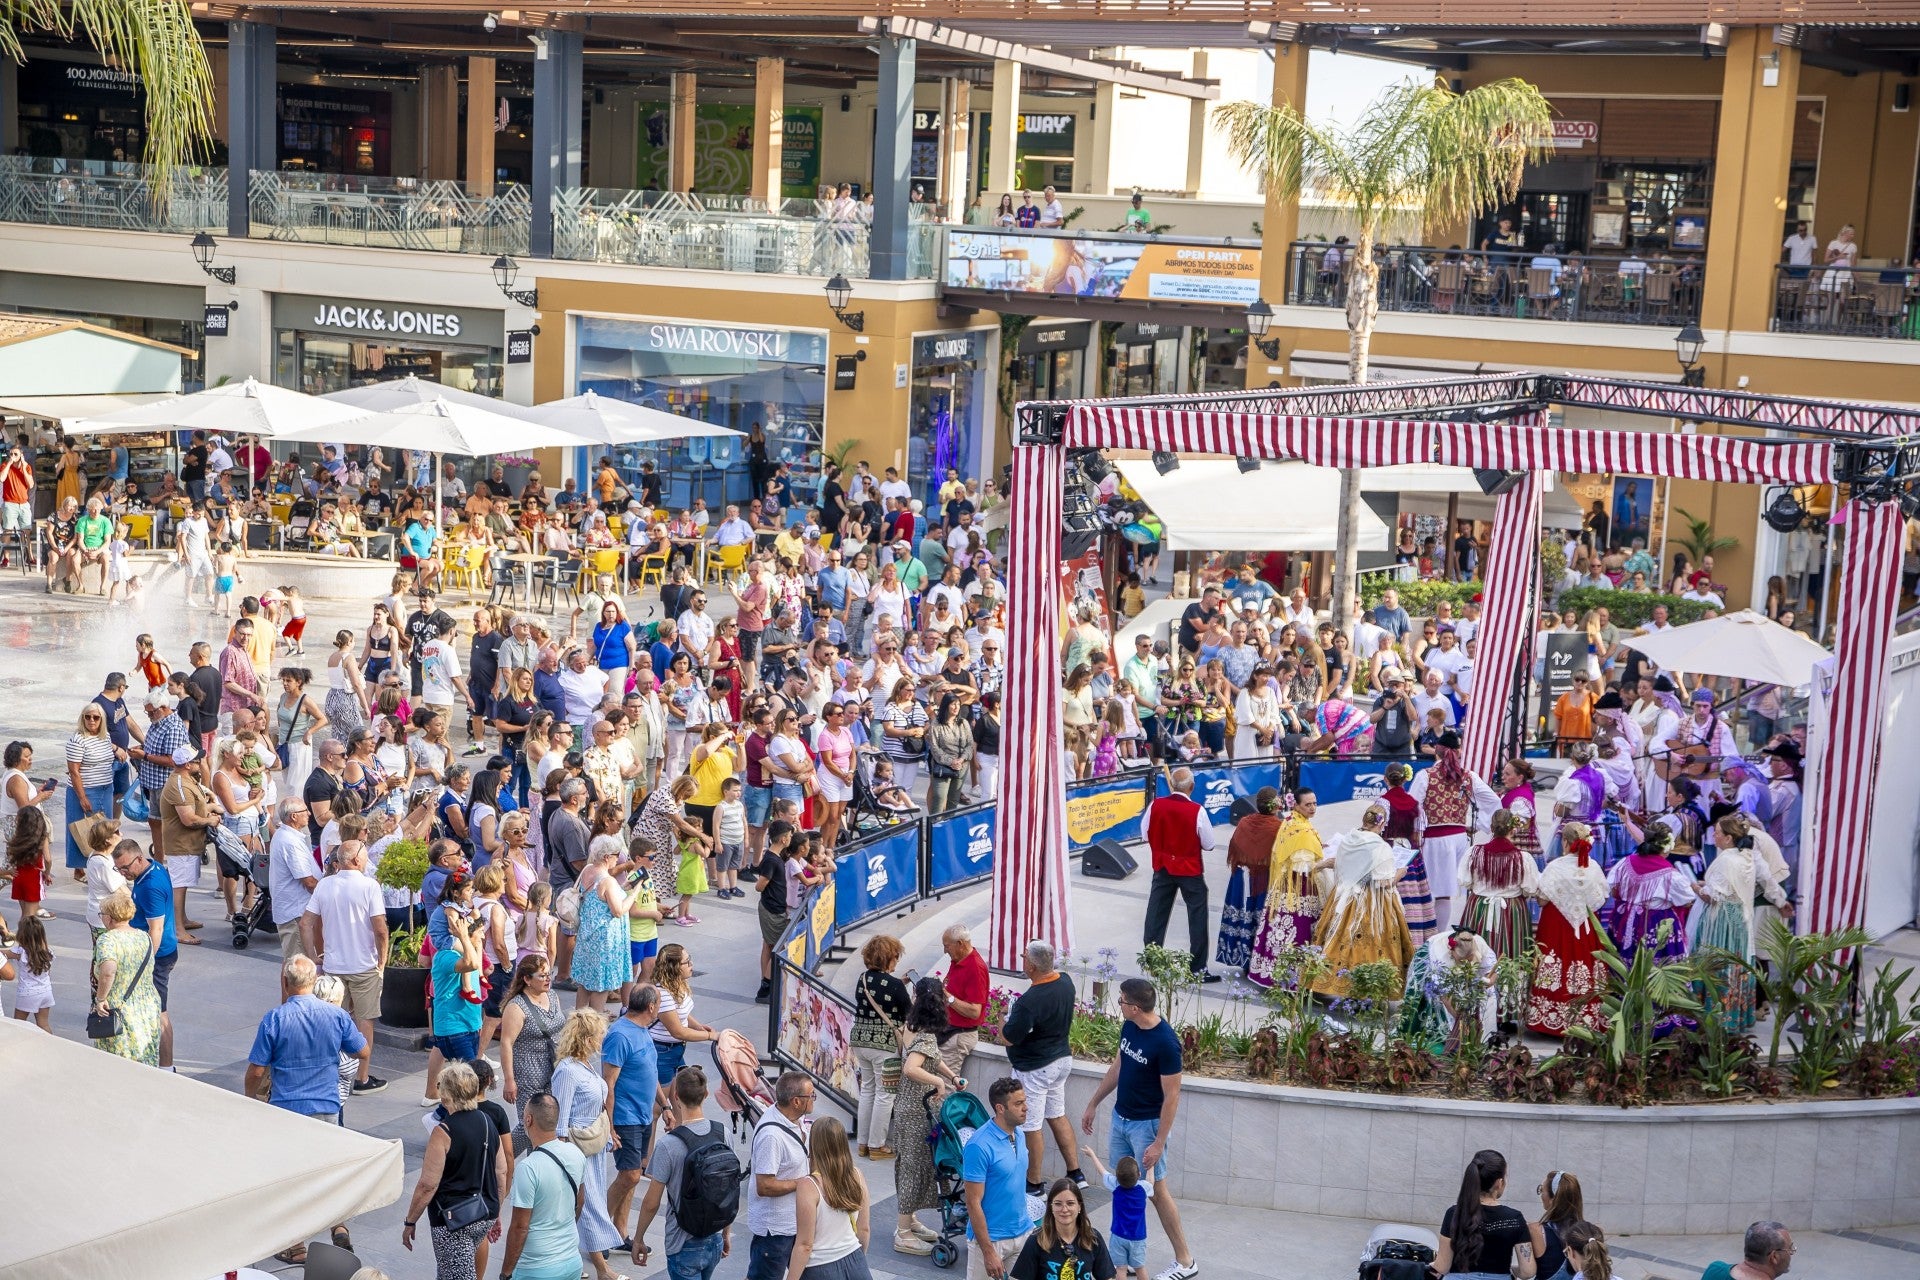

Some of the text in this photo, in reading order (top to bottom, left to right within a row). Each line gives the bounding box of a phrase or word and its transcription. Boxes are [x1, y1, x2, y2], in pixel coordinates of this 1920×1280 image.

[66, 67, 87, 79] 100
[286, 99, 313, 108] BIGGER
[1177, 249, 1242, 262] OPEN PARTY
[1165, 259, 1197, 268] ABRIMOS
[1198, 261, 1221, 269] TODOS
[1223, 262, 1237, 270] LOS
[206, 321, 227, 329] JONES
[650, 325, 782, 357] SWAROVSKI
[510, 348, 530, 356] JONES
[935, 338, 968, 359] SWAROVSKI
[1205, 793, 1235, 804] ZENIA
[967, 837, 993, 852] ZENIA
[867, 869, 888, 885] ZENIA
